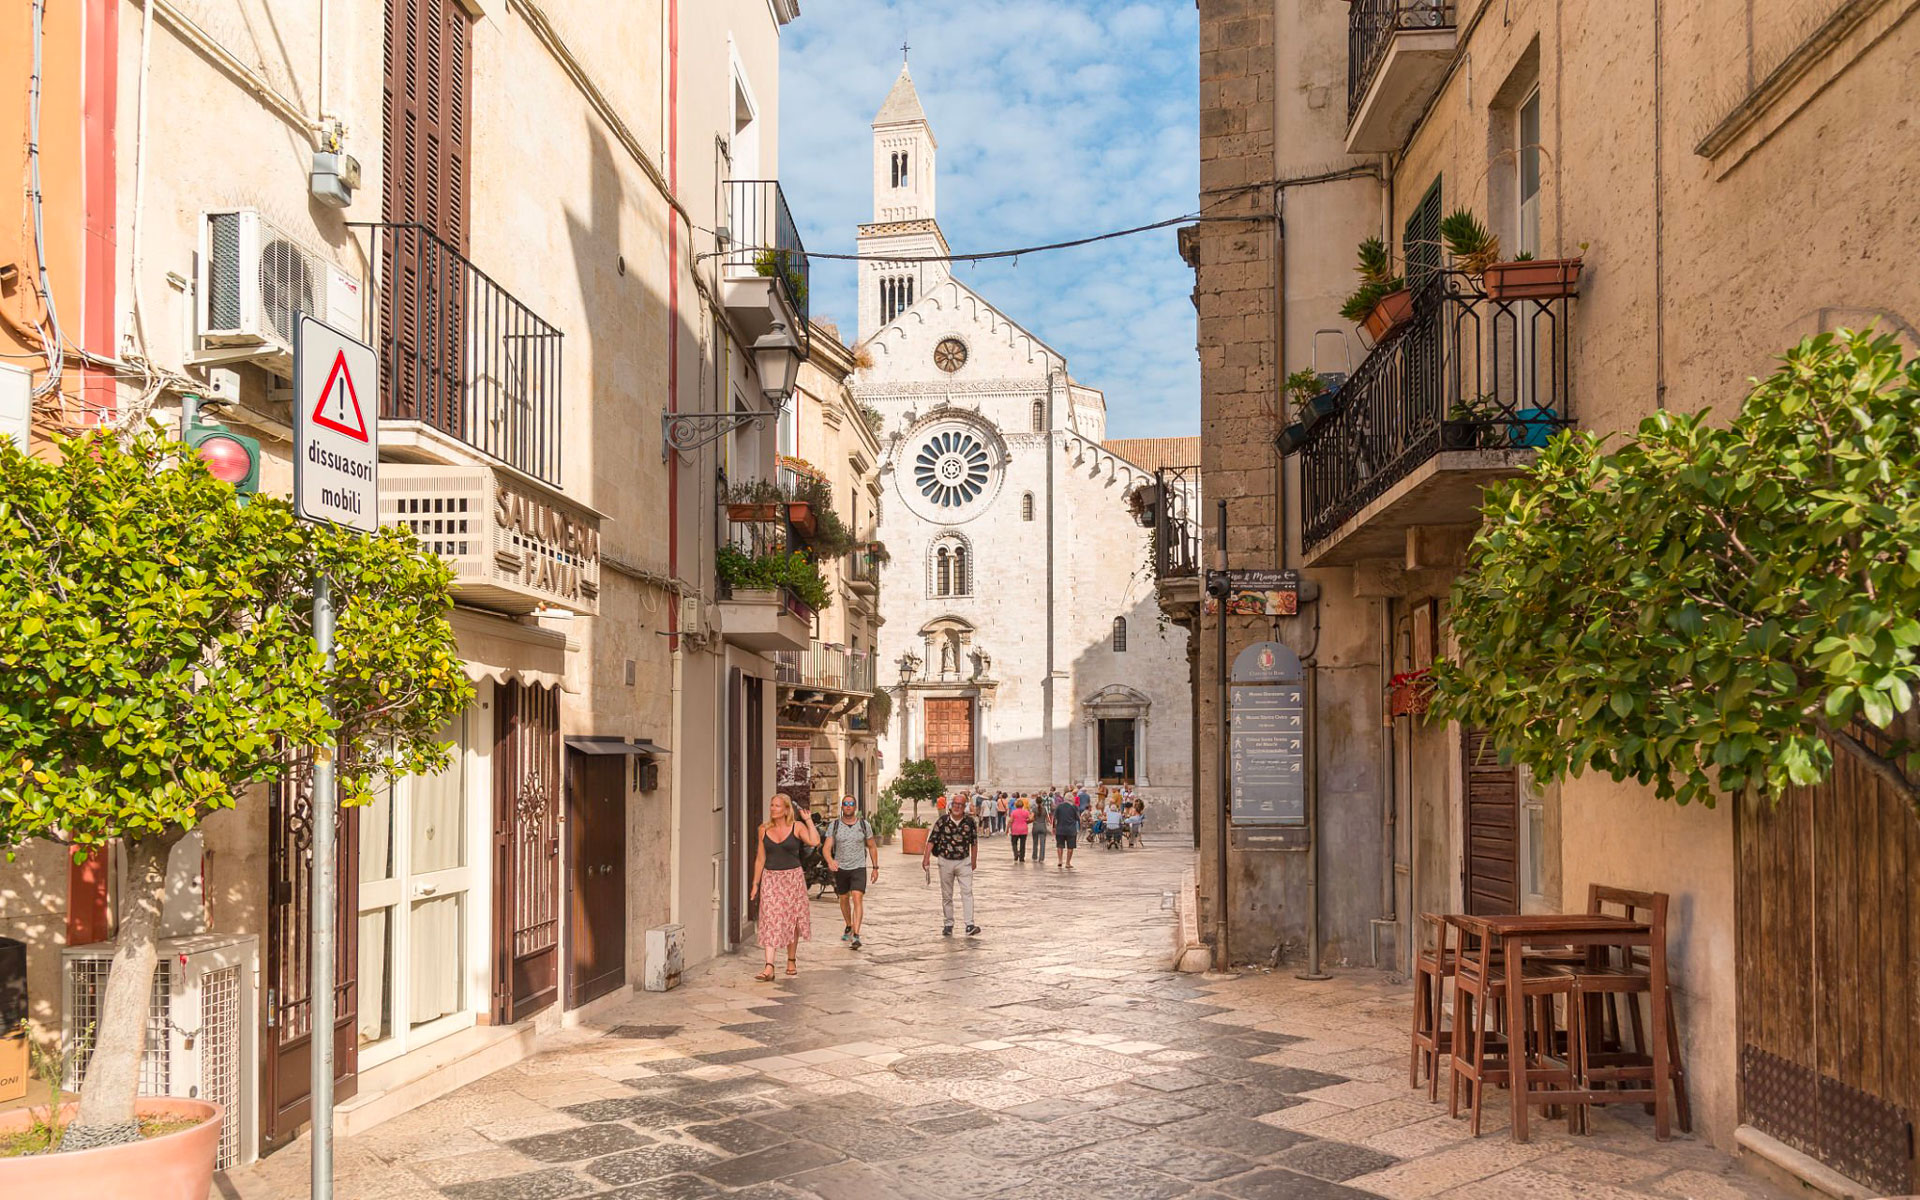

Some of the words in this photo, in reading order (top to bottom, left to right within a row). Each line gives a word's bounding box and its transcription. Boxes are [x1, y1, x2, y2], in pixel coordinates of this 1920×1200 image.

[308, 439, 372, 482] dissuasori
[322, 487, 361, 515] mobili
[495, 486, 600, 566] SALUMERIA
[525, 552, 578, 601] FAVIA
[0, 1075, 19, 1086] ONI
